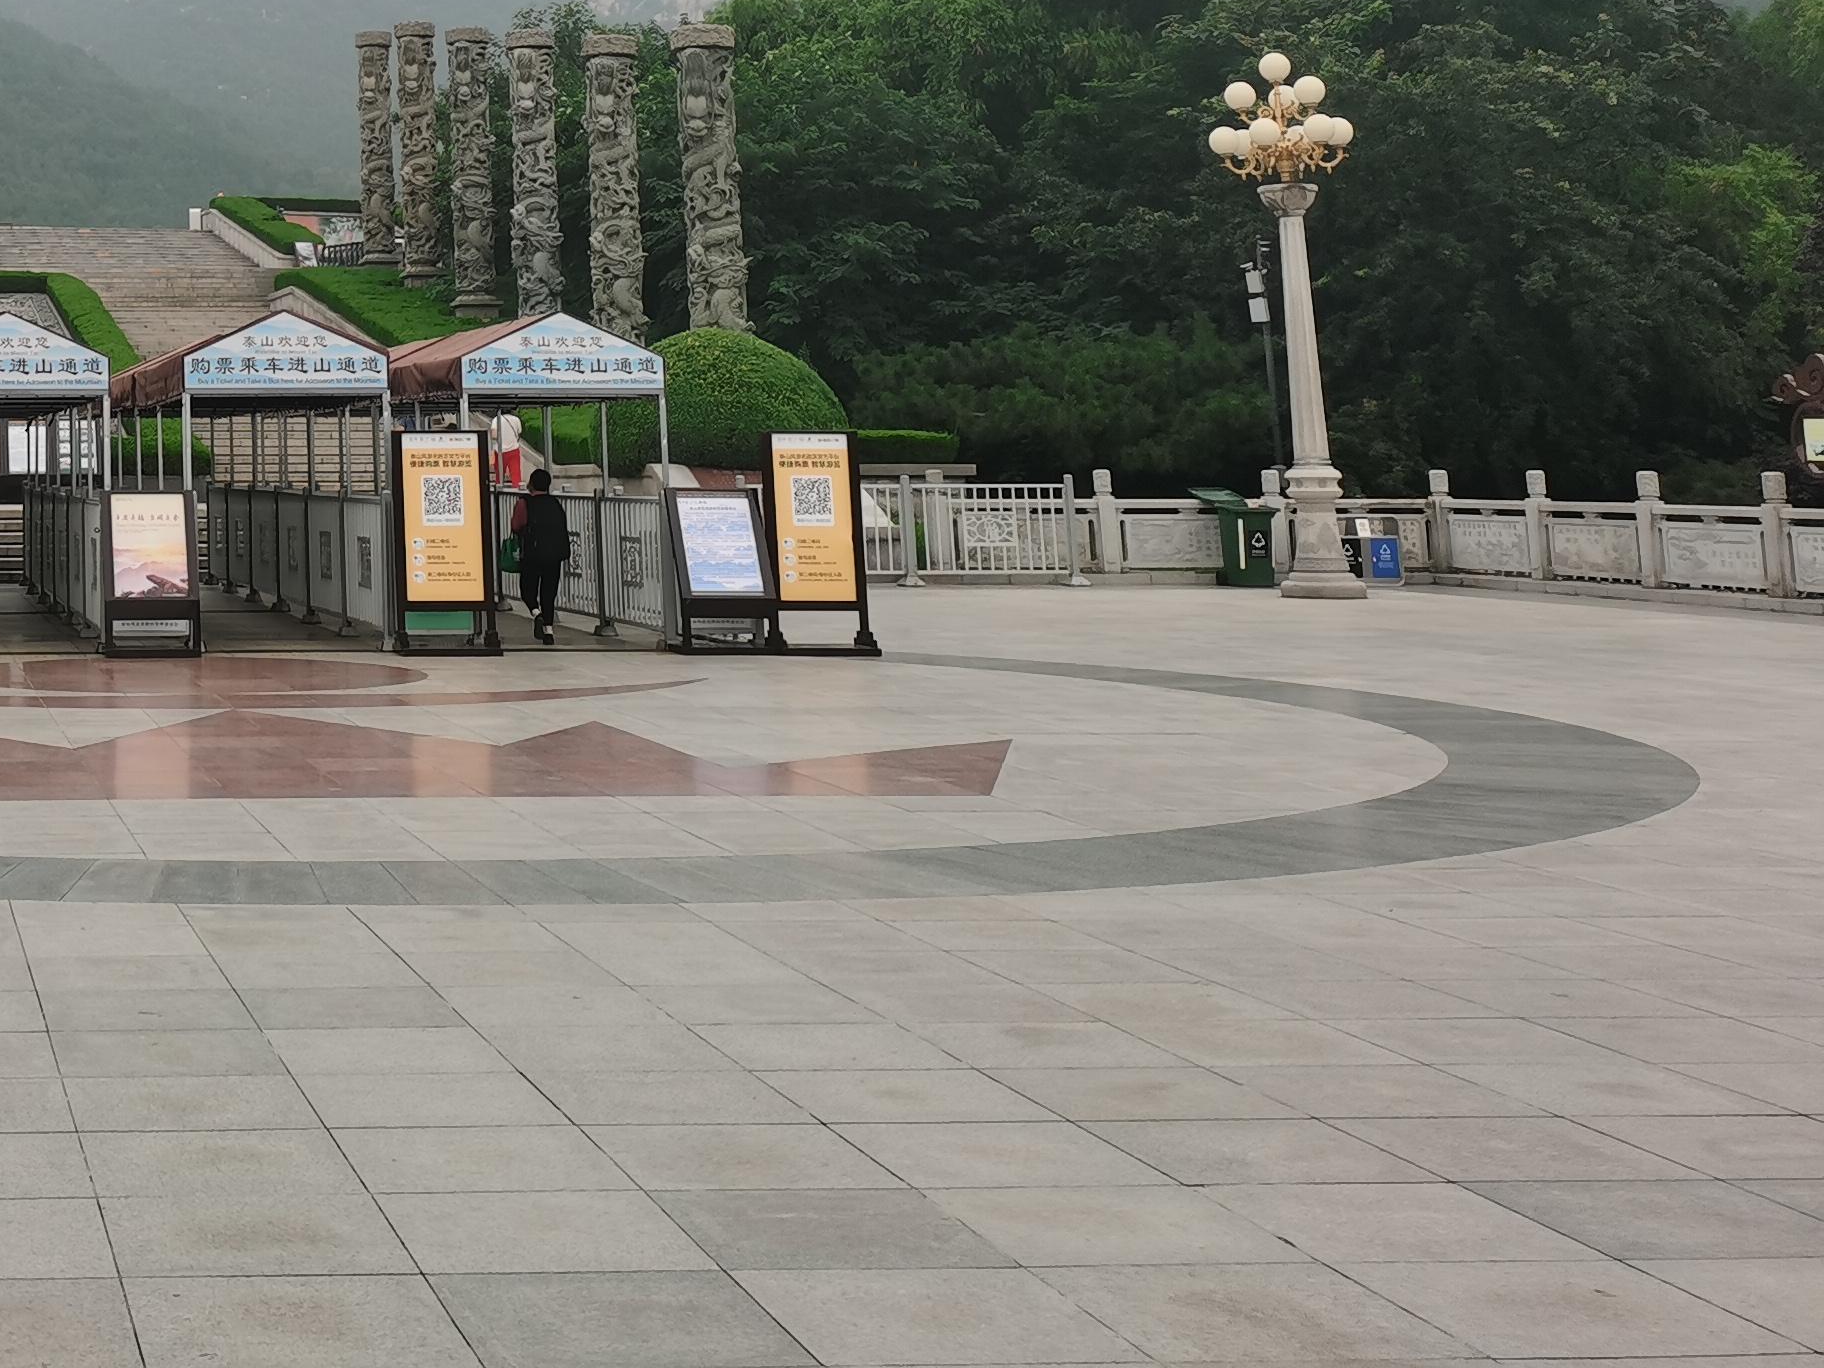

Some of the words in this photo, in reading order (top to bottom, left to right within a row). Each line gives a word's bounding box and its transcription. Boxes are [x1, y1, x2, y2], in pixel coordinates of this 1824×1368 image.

[242, 335, 329, 348] 泰山欢迎您
[519, 335, 605, 348] 泰山欢迎您
[190, 356, 382, 374] 购票乘车进山通道
[466, 357, 658, 374] 购票乘车进山通道
